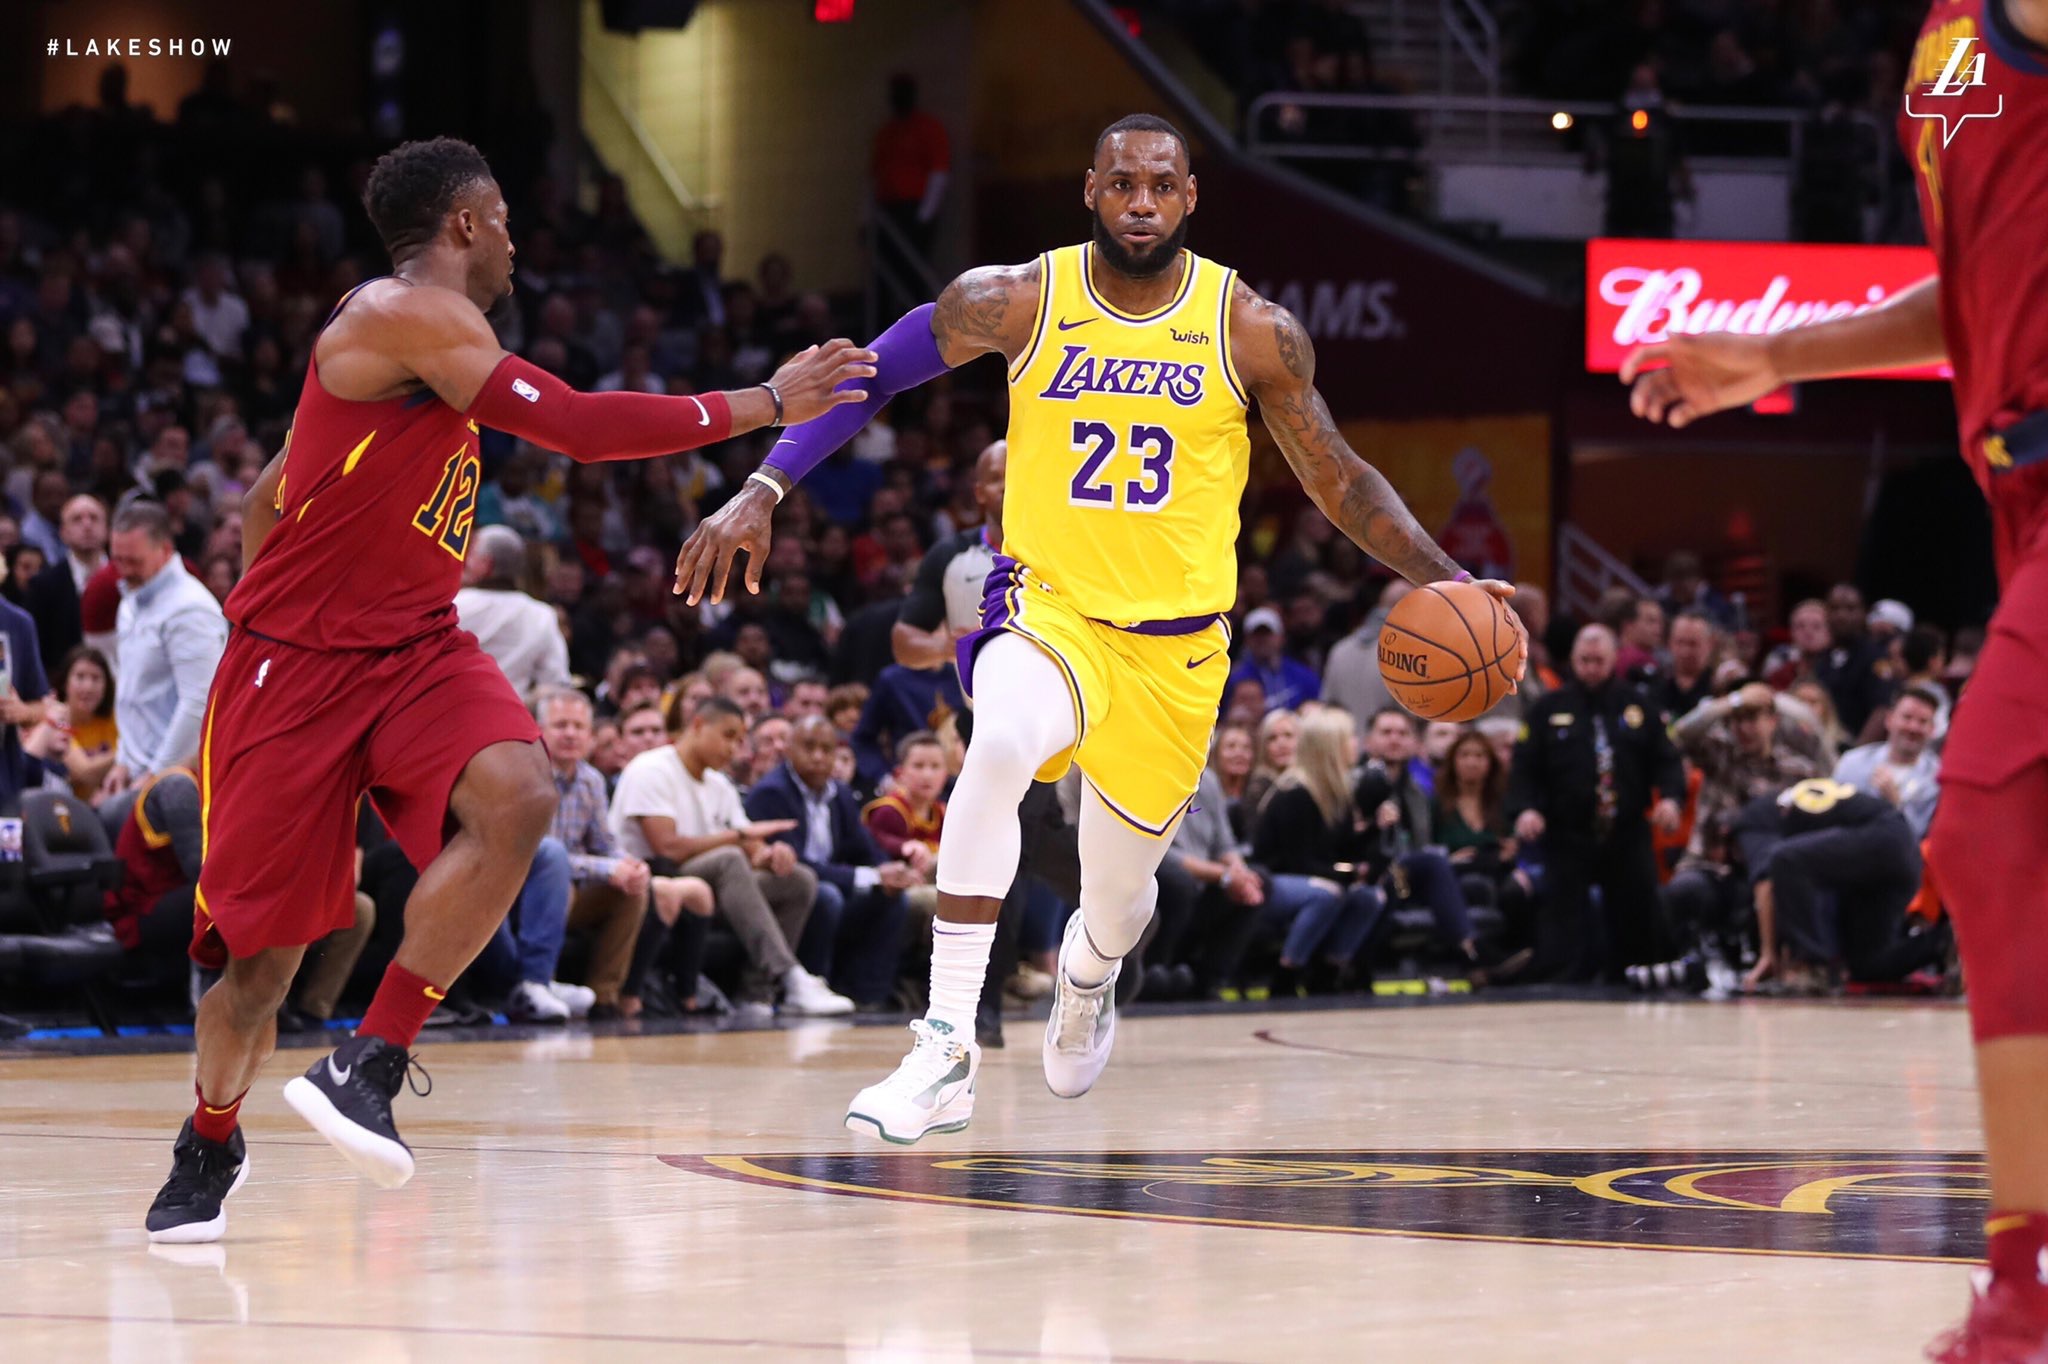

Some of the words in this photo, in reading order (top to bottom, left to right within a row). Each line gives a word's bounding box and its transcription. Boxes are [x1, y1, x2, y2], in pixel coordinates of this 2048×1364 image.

[1169, 328, 1209, 345] wish
[1039, 345, 1205, 407] LAKERS
[412, 442, 480, 561] 12
[1069, 419, 1175, 512] 23
